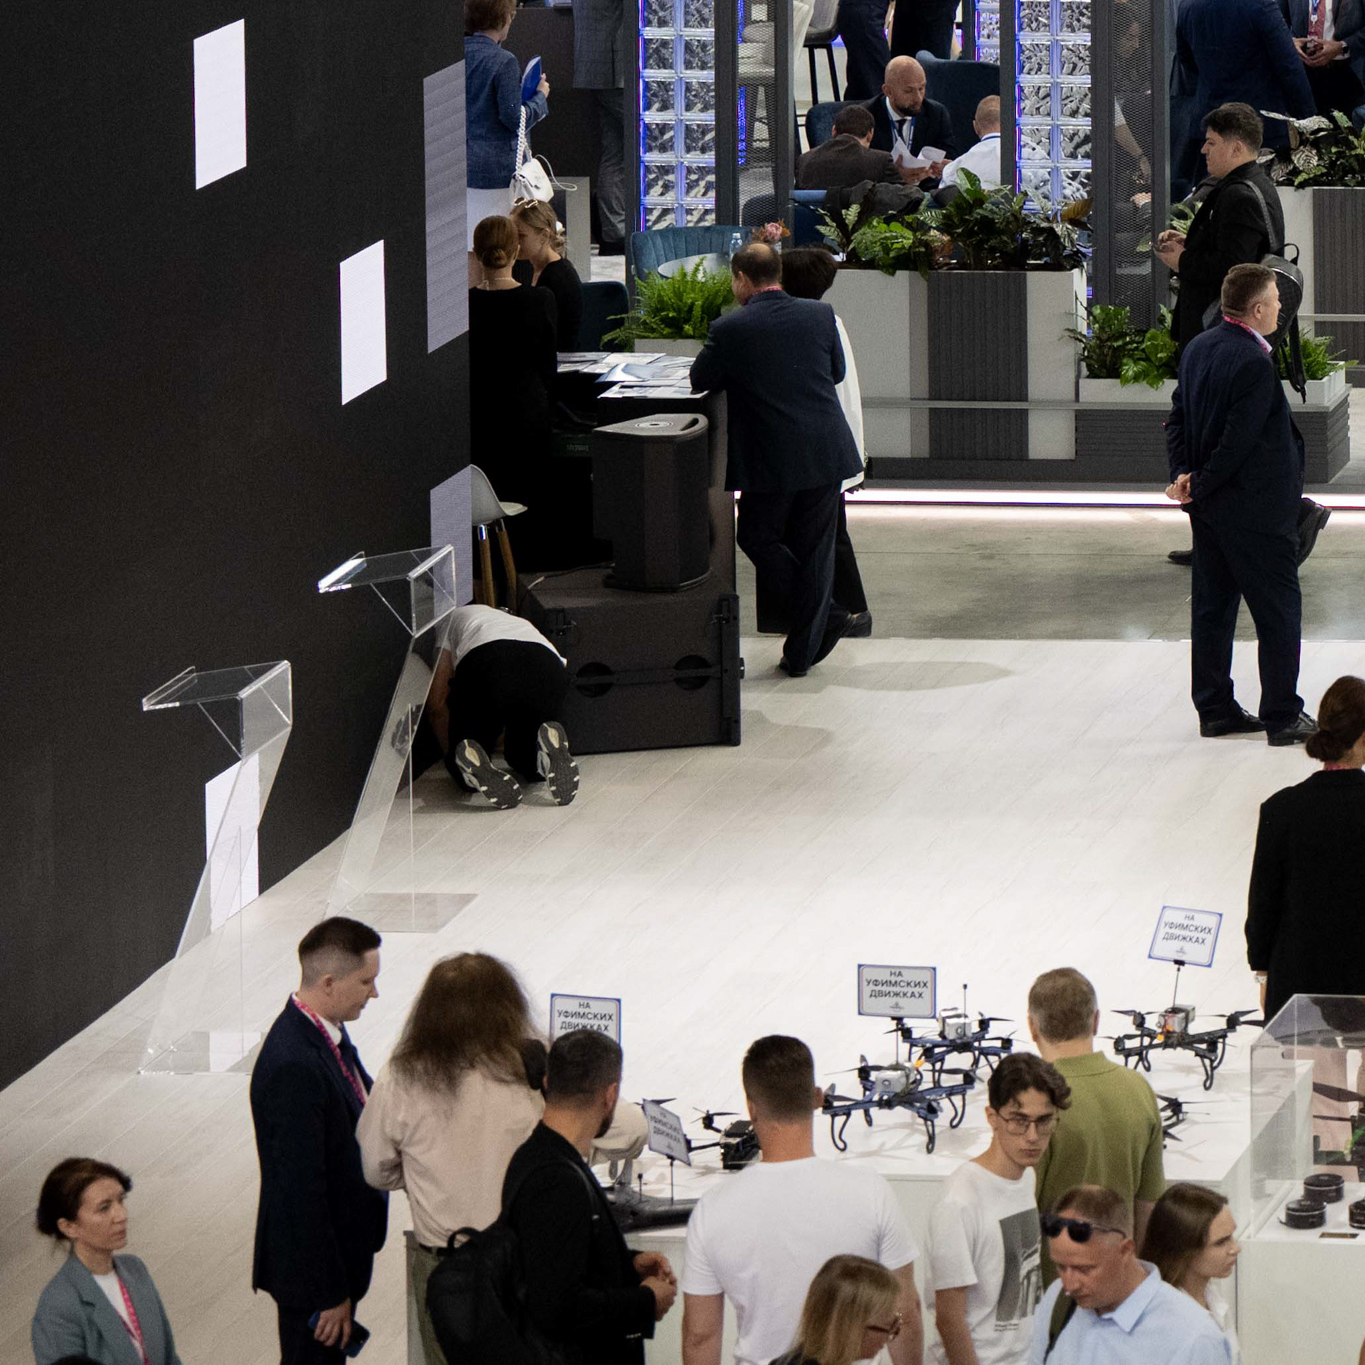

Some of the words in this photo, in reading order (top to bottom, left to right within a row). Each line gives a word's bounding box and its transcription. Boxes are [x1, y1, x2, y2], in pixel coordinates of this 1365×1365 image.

[1184, 913, 1195, 922] НА
[1163, 920, 1214, 935] УФИМСКИХ
[1161, 931, 1207, 946] ДВИЖКАХ
[889, 970, 903, 978] НА
[865, 978, 929, 989] УФИМСКИХ
[869, 989, 924, 999] ДВИЖКАХ
[578, 1001, 591, 1009] НА
[556, 1009, 614, 1022] УФИМСКИХ
